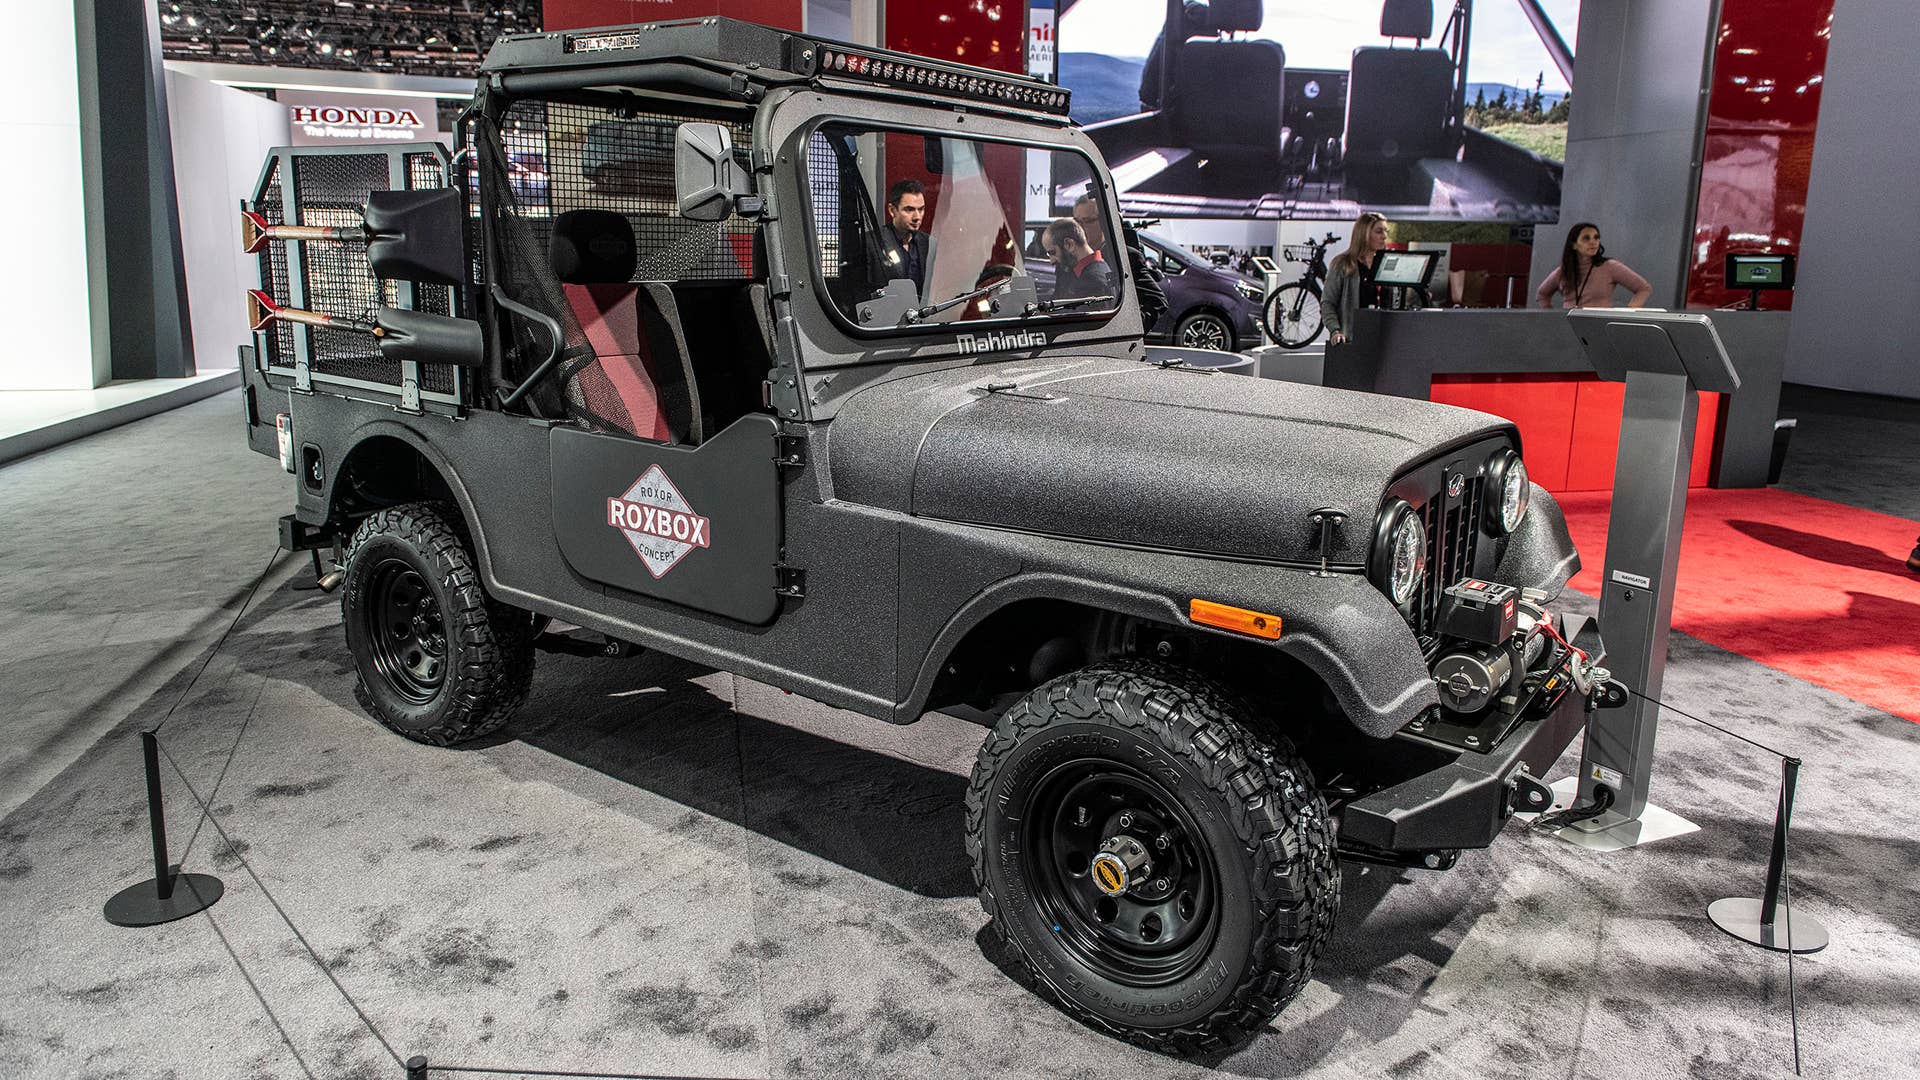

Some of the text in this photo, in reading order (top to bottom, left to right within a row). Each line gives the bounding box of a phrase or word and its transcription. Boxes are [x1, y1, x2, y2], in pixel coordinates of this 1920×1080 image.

[292, 106, 423, 127] HONDA
[956, 329, 1047, 355] Mahindra
[641, 487, 672, 502] ROXOR
[610, 499, 705, 545] ROXBOX
[639, 543, 675, 561] CONCEPT
[1621, 575, 1647, 584] NAVIGATOR
